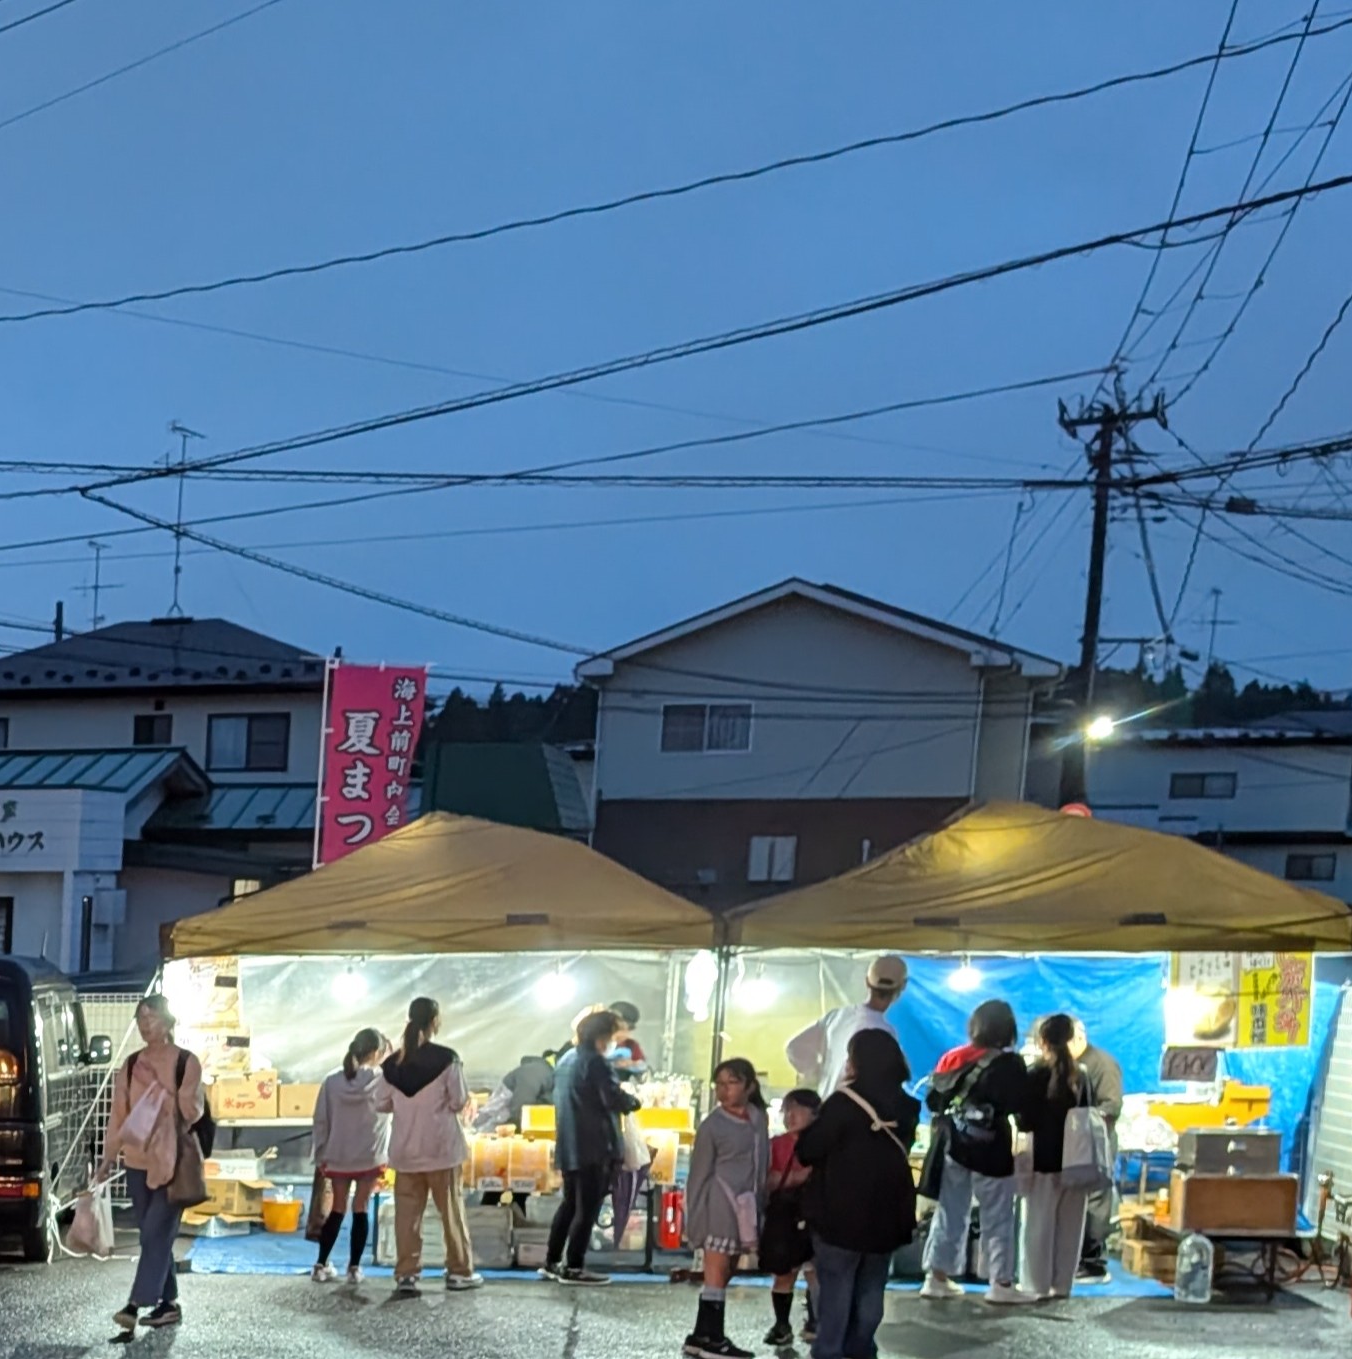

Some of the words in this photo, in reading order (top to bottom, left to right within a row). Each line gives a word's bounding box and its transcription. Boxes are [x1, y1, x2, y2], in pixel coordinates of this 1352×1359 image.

[336, 711, 381, 844] 夏まつ
[384, 677, 418, 826] 海上前町内会
